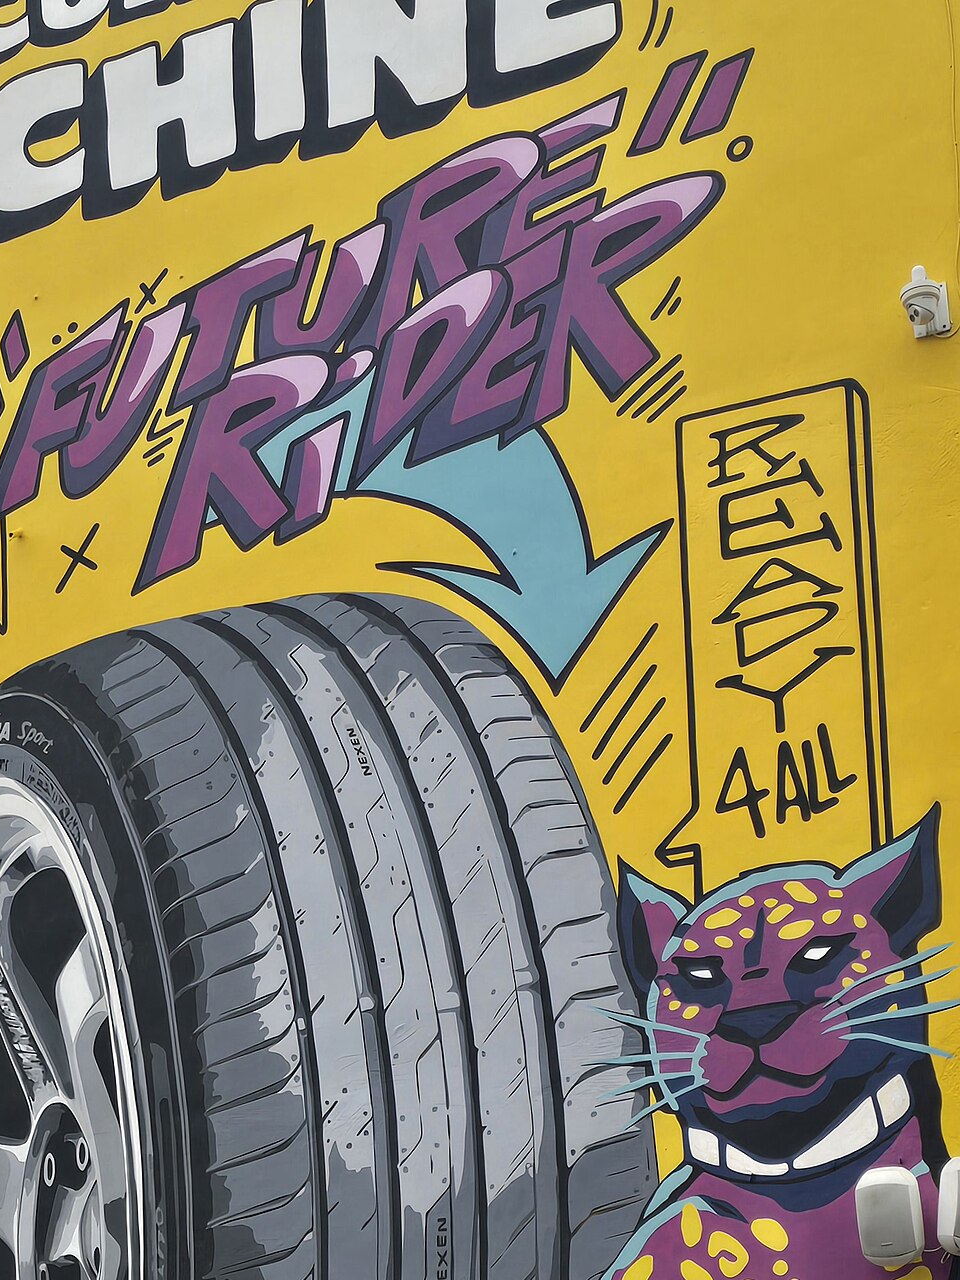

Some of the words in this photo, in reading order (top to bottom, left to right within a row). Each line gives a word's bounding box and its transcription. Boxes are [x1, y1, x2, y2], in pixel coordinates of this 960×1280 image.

[707, 413, 855, 733] READY
[16, 721, 54, 754] Sport
[346, 727, 373, 776] NEXEN
[715, 746, 770, 839] 4
[776, 723, 857, 824] ALL
